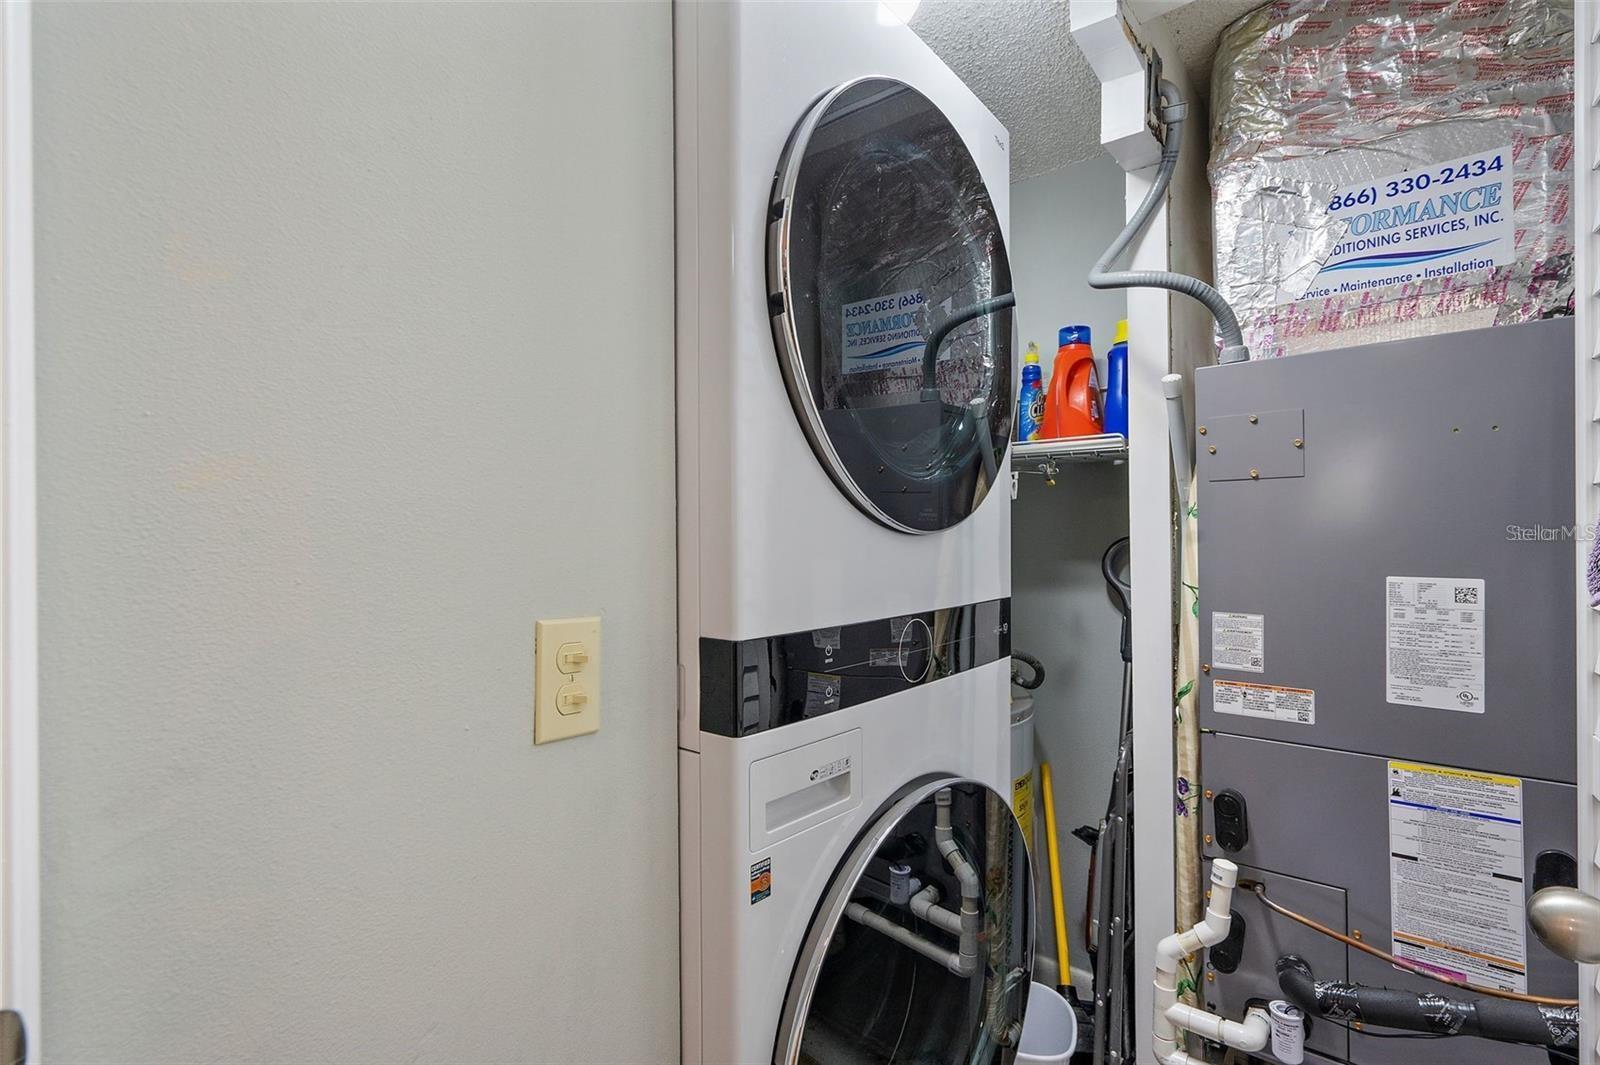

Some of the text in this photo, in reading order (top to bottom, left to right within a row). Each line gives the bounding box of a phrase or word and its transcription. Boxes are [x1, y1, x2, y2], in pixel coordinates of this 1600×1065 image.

[1326, 155, 1504, 213] 866) 330-2434
[1331, 211, 1504, 256] DITIONING SERVICES, INC.
[1340, 274, 1413, 293] Maintenance
[1424, 258, 1494, 278] Installation
